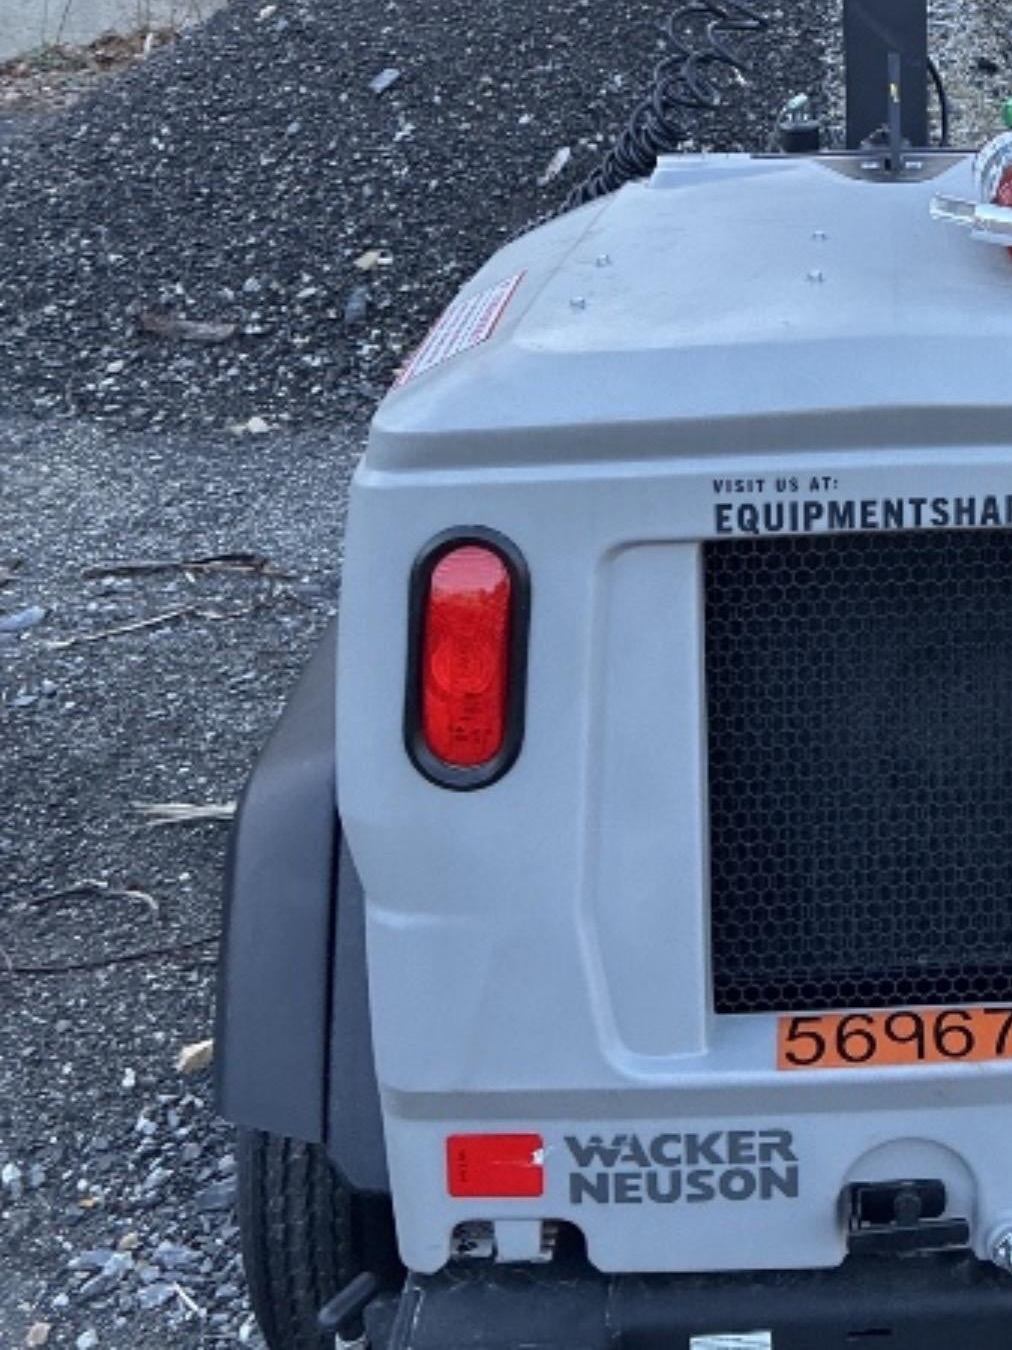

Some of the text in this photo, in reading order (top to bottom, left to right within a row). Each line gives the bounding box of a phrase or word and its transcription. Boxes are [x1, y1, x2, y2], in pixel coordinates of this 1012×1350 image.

[713, 476, 839, 494] VISIT US AT:
[564, 1129, 799, 1169] WACKER
[570, 1166, 799, 1204] NEUSON
